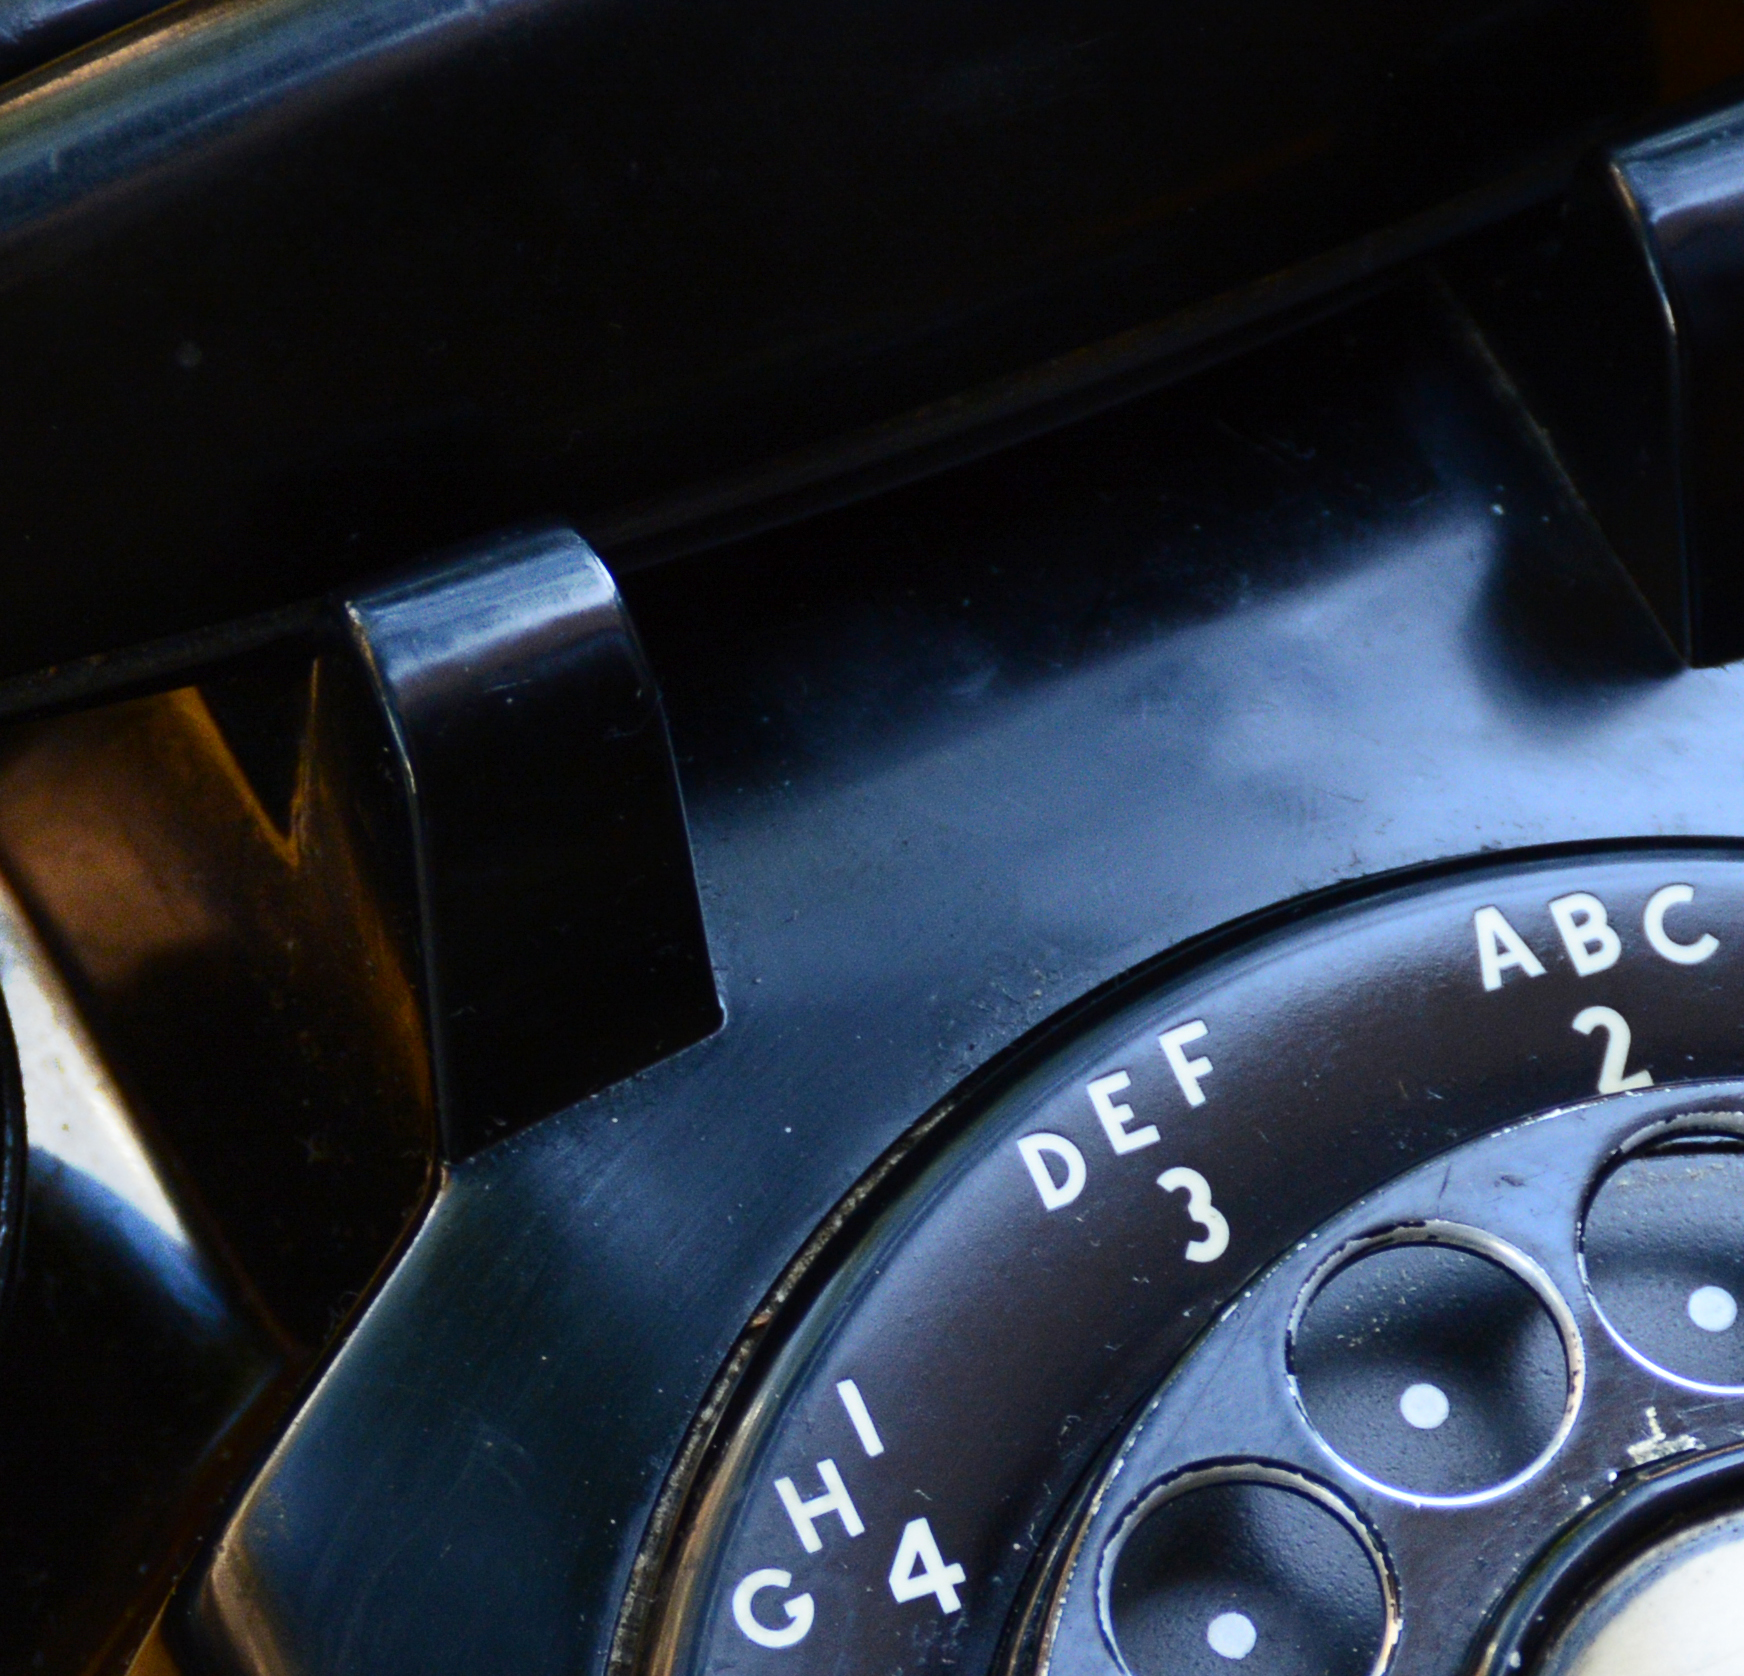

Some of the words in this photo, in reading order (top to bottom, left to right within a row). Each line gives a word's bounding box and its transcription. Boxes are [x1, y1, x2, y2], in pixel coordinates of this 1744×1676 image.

[1473, 883, 1719, 991] ABC
[1571, 1004, 1652, 1096] 2
[1017, 1019, 1214, 1211] DEF
[1156, 1166, 1230, 1263] 3
[888, 1517, 966, 1614] 4
